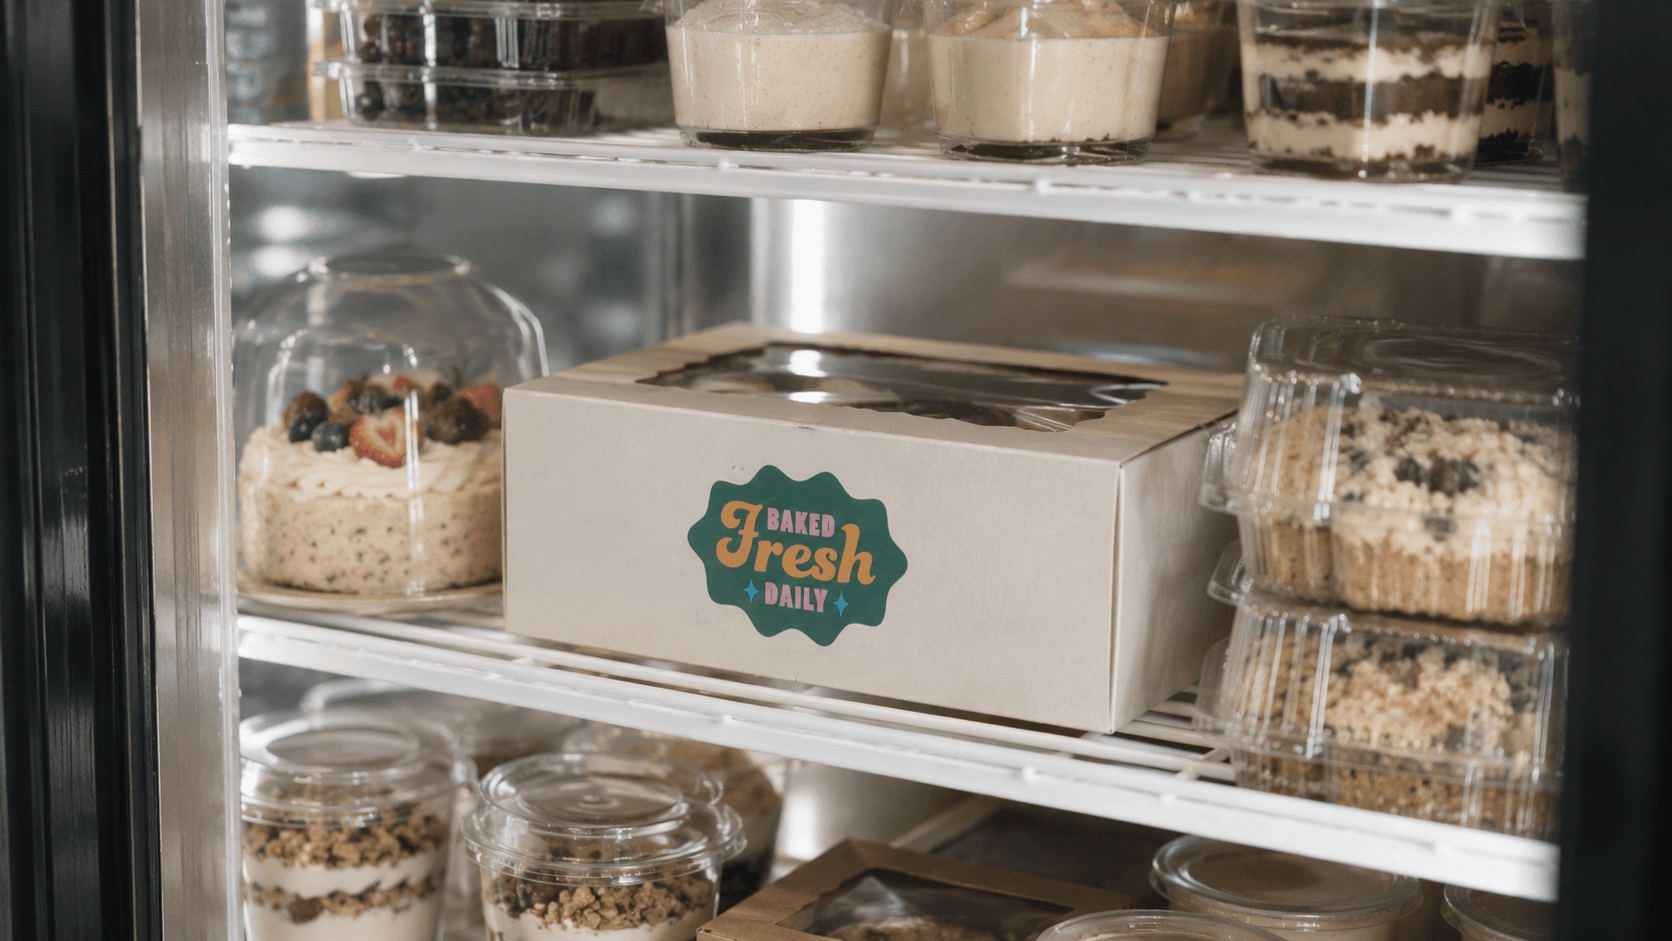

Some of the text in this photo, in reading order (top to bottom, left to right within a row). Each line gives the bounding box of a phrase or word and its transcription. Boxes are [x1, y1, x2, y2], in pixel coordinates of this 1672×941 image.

[767, 507, 835, 538] BAKED
[716, 500, 876, 585] Fresh
[765, 582, 828, 613] DAILY
